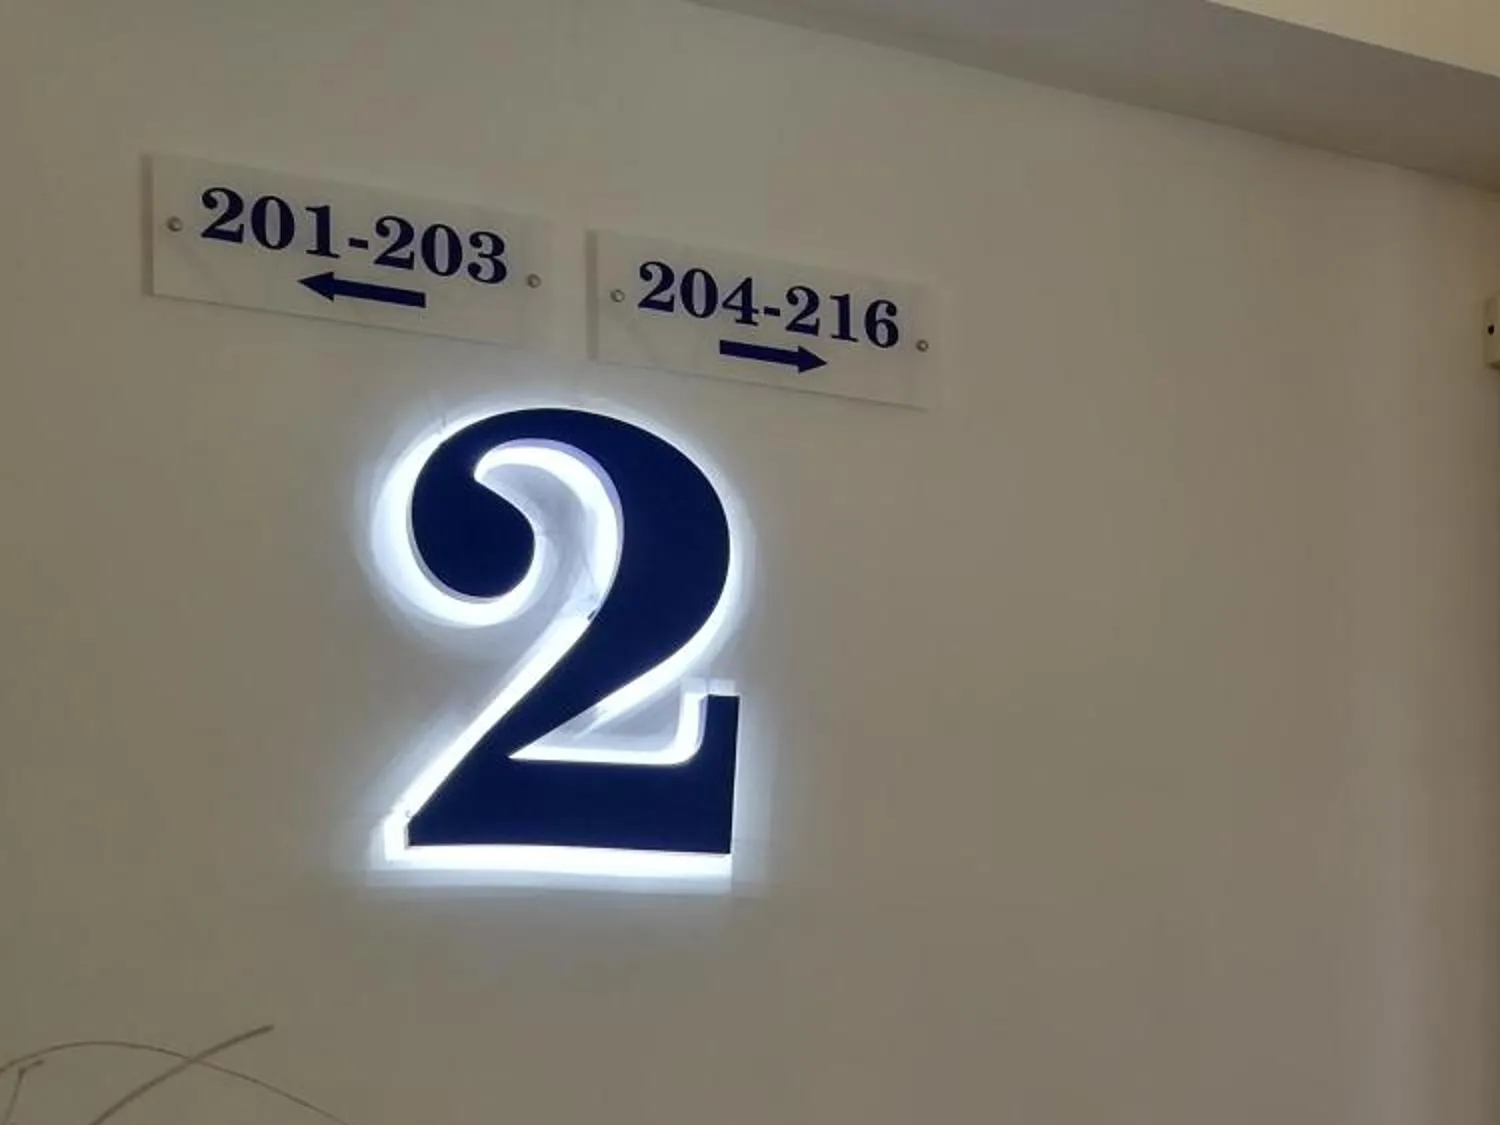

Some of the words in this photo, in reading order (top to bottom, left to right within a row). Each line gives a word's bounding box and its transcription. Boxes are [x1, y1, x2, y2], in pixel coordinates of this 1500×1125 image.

[199, 186, 509, 286] 201-203
[637, 259, 901, 350] 204-216
[409, 407, 740, 854] 2
